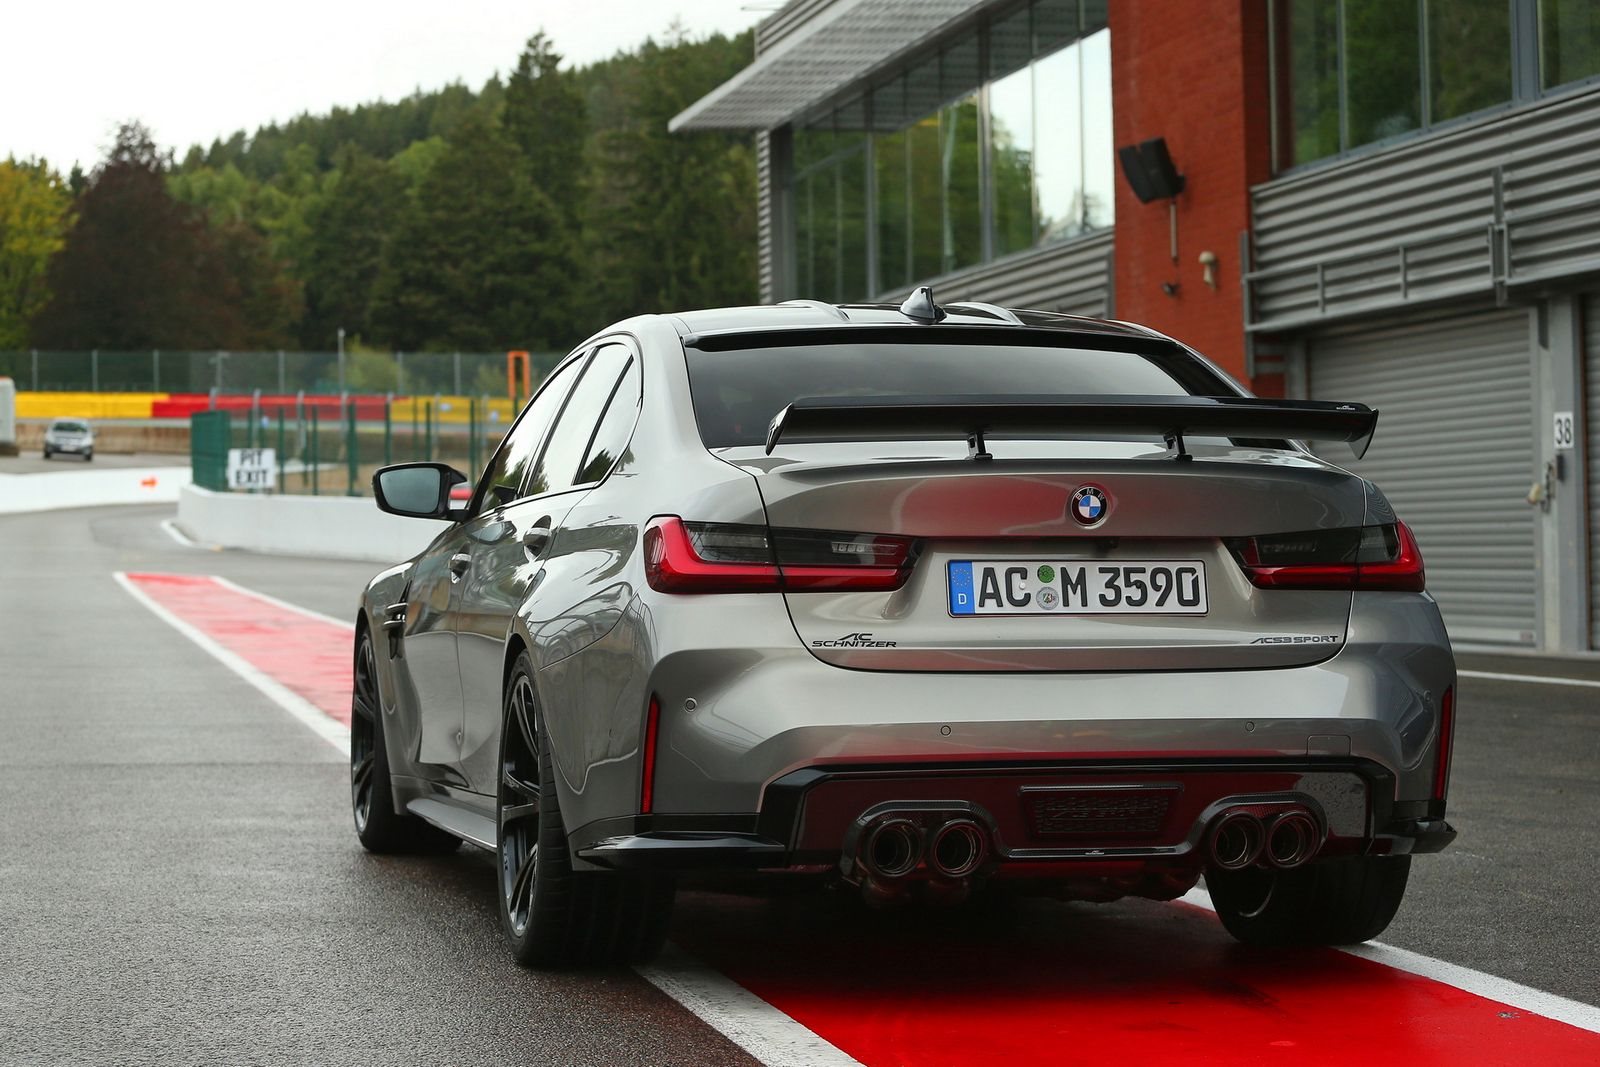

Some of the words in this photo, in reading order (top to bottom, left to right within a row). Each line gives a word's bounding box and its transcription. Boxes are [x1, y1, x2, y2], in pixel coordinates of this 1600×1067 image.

[1555, 418, 1571, 444] 38
[240, 449, 264, 466] PIT
[236, 469, 269, 484] EXIT
[1075, 488, 1105, 500] BMW
[979, 567, 1031, 607] AC
[1060, 567, 1088, 607] M
[1098, 567, 1200, 607] 3590
[958, 593, 967, 605] D
[838, 632, 873, 641] AC
[1293, 635, 1339, 643] SPORT
[811, 640, 897, 648] SCHNITZER
